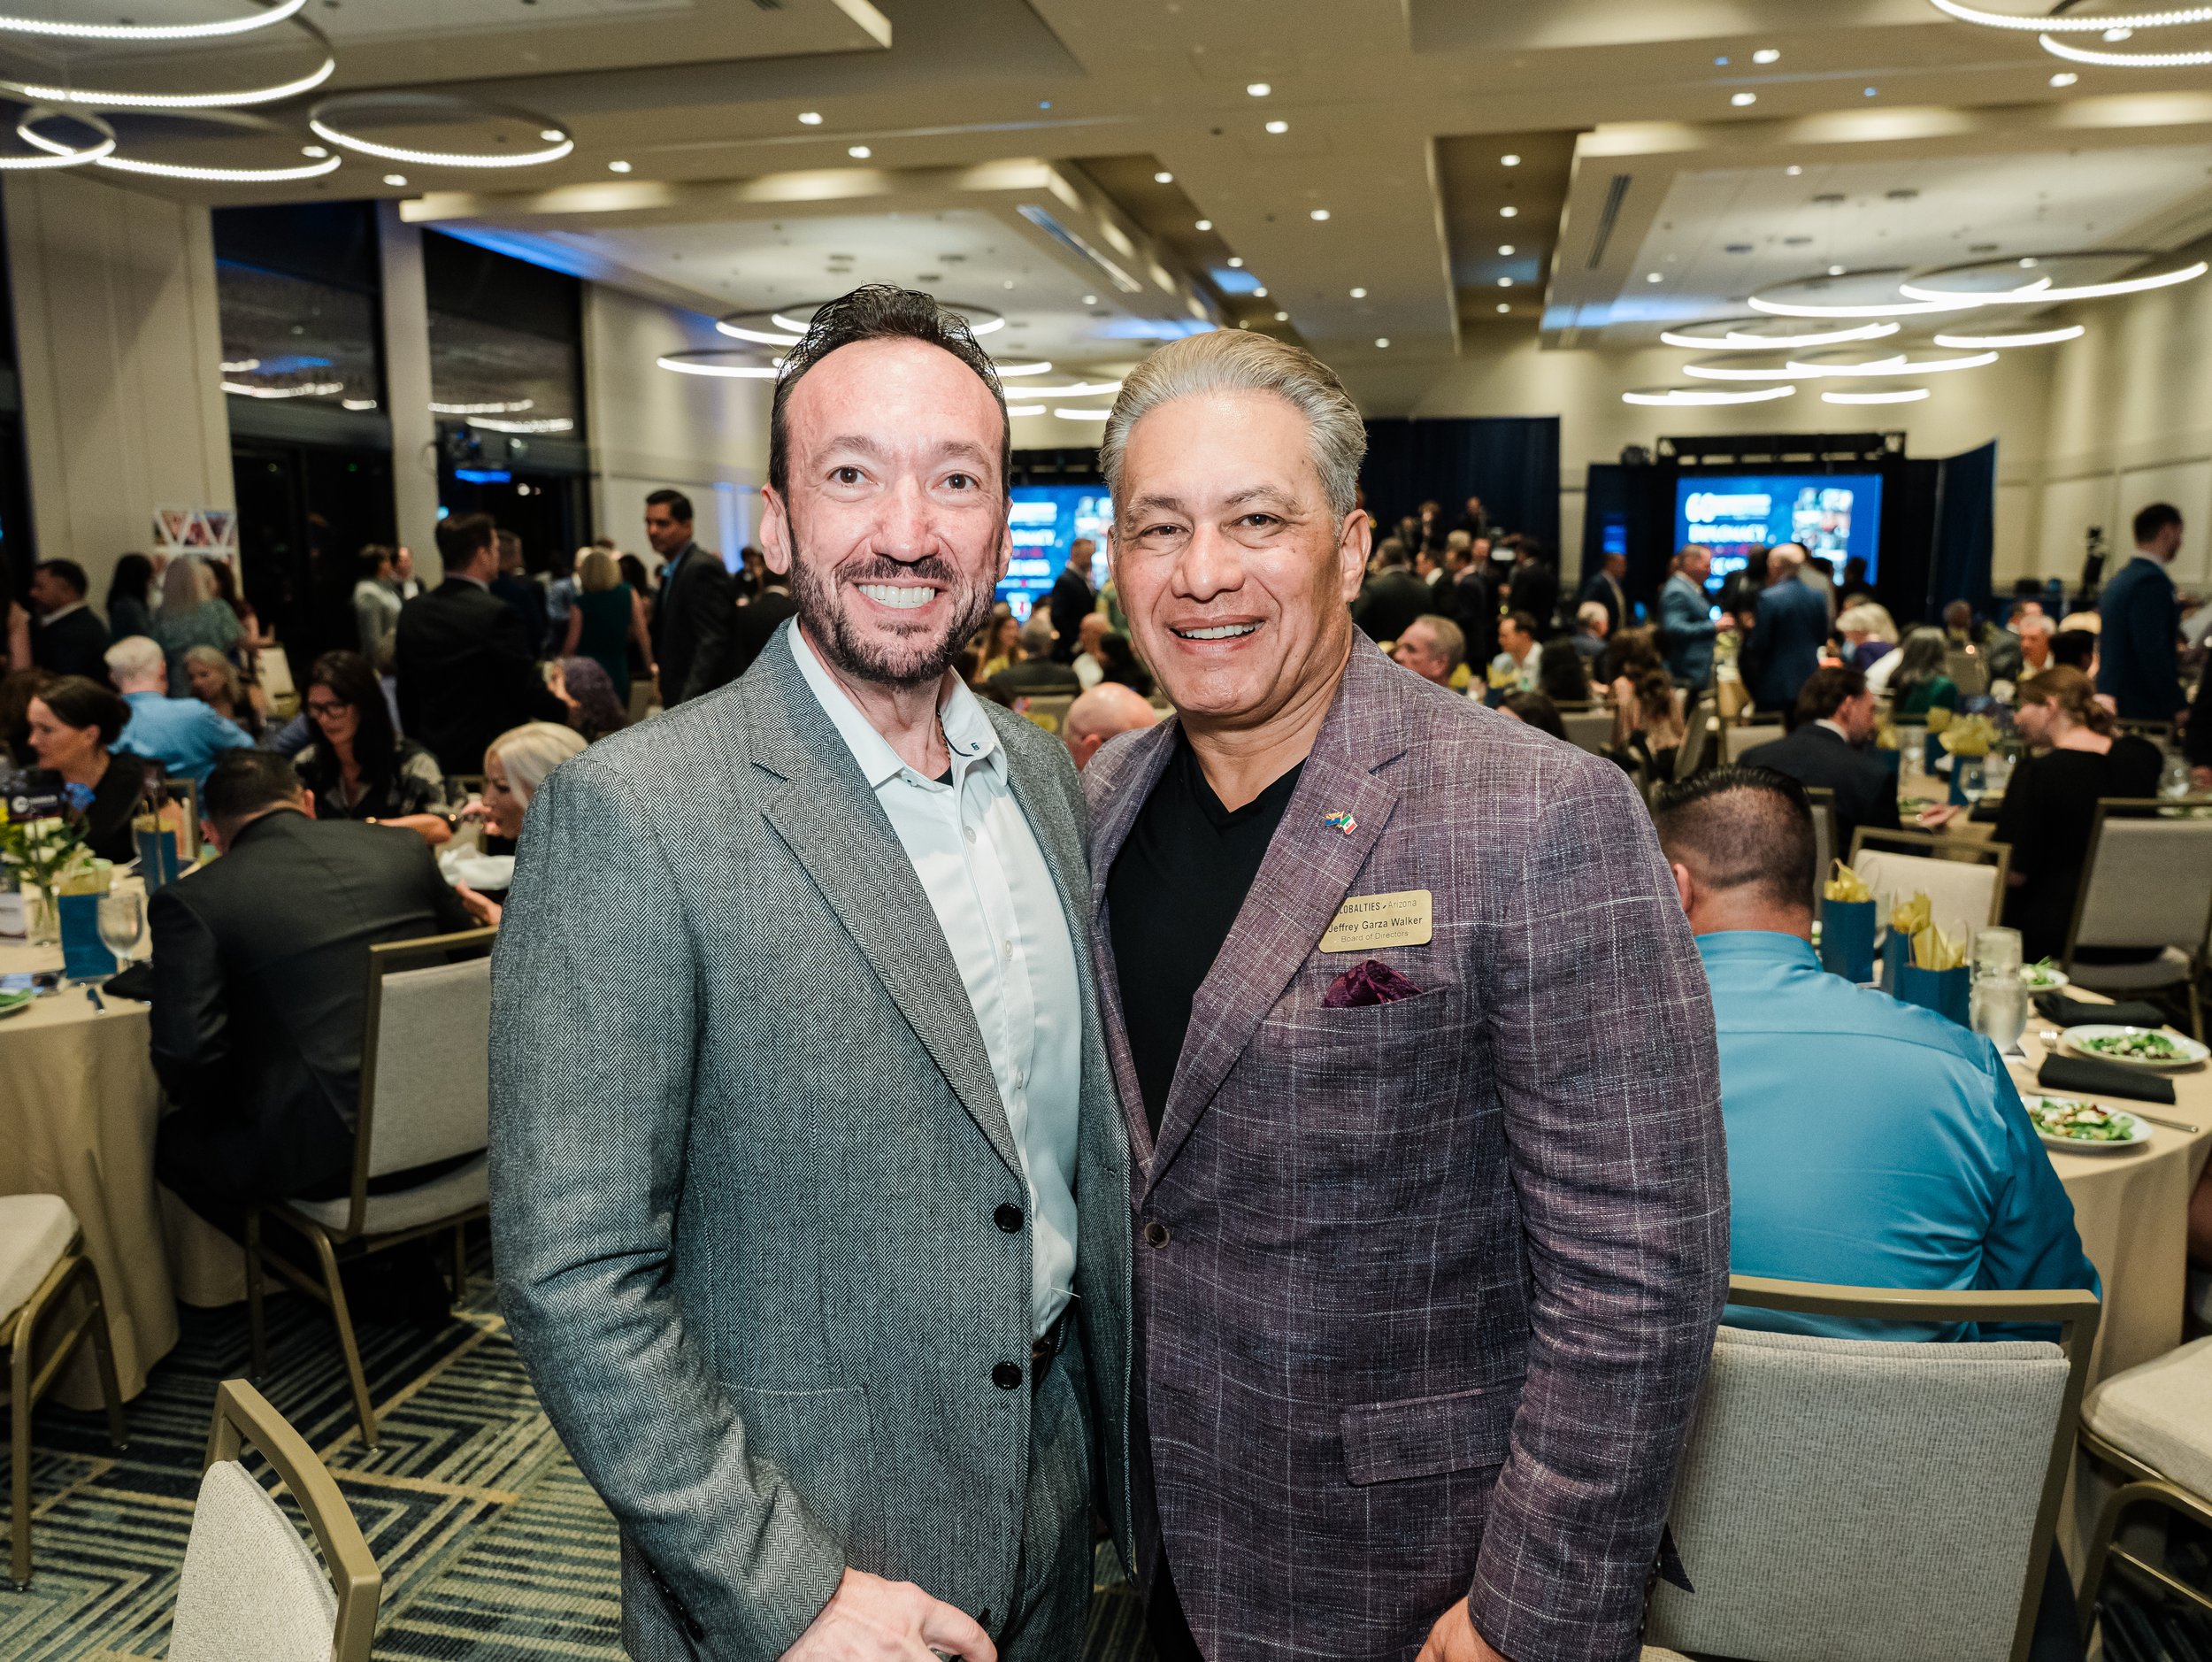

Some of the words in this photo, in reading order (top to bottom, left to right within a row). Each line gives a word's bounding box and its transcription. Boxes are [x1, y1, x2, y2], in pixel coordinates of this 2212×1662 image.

[1339, 902, 1381, 914] LOBALTIES
[1388, 899, 1417, 909] Arizona
[1328, 923, 1359, 933] Jeffrey
[1362, 920, 1388, 929] Garza
[1391, 917, 1423, 927] Walker
[1340, 933, 1363, 943] Board
[1375, 931, 1409, 940] Directors
